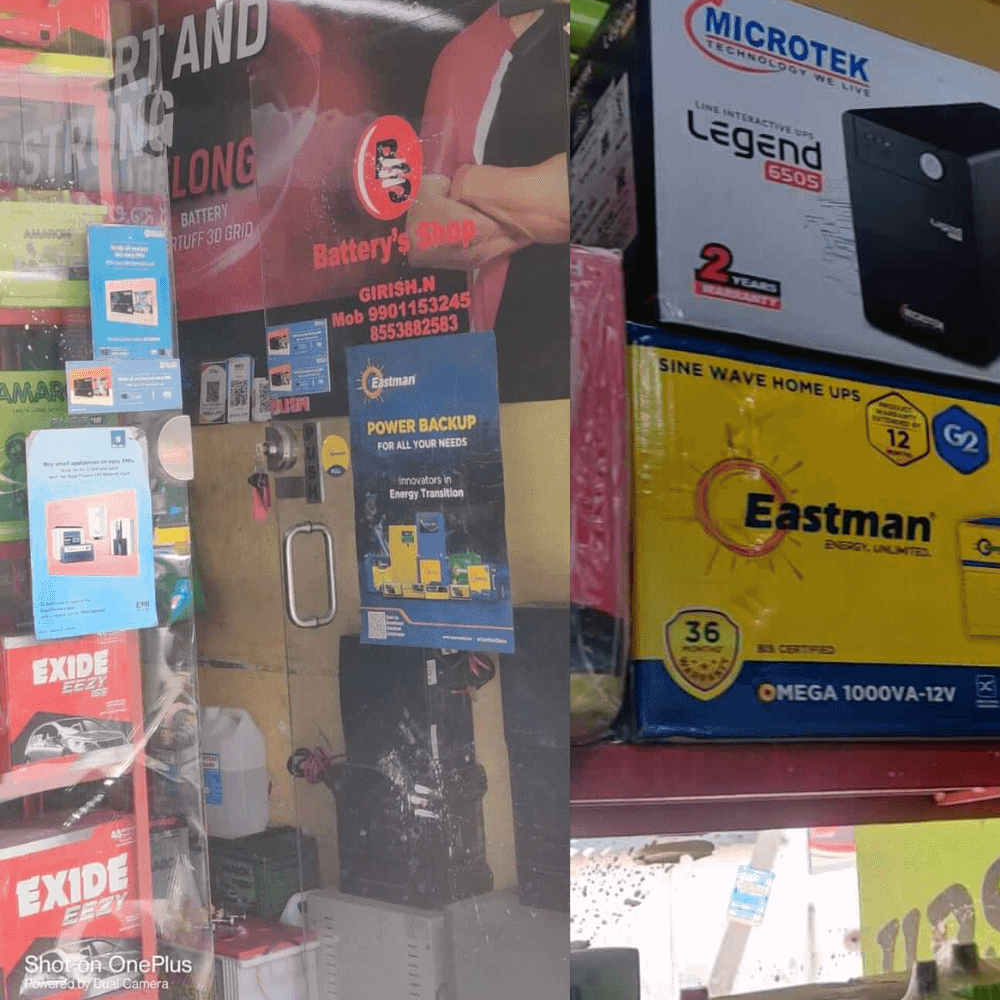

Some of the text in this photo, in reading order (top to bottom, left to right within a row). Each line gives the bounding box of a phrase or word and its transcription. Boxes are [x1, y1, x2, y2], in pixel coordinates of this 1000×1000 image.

[171, 0, 268, 79] AND
[704, 6, 871, 83] MICROTEK
[706, 39, 872, 98] TECHNOLOGY WE LIVE
[695, 101, 814, 141] LINE INTERACTIVE UPS
[686, 110, 822, 171] Legend
[171, 136, 259, 200] LONG
[181, 204, 229, 228] BATTERY
[206, 221, 254, 245] 3D GRID
[313, 218, 477, 271] Battery's Shop
[698, 243, 778, 294] 2 YEARS
[358, 276, 436, 303] GIRISH.N
[331, 291, 471, 328] Mob 9901153245
[371, 374, 416, 389] Eastman
[658, 358, 861, 402] SINE WAVE HOME UPS
[366, 414, 477, 436] POWER BACKUP
[887, 430, 911, 452] 12
[942, 423, 980, 454] G2
[377, 437, 468, 452] FOR ALL YOUR NEEDS
[389, 487, 464, 501] Energy Transition
[398, 475, 453, 486] Innovators in
[744, 492, 932, 543] Eastman
[685, 620, 720, 644] 36
[778, 644, 836, 655] CERTIFIED
[32, 650, 110, 685] EXIDE
[62, 675, 108, 695] EEZY
[756, 682, 957, 703] OMEGA 1000VA-12V
[15, 853, 129, 918] EXIDE
[62, 891, 129, 927] EEZY
